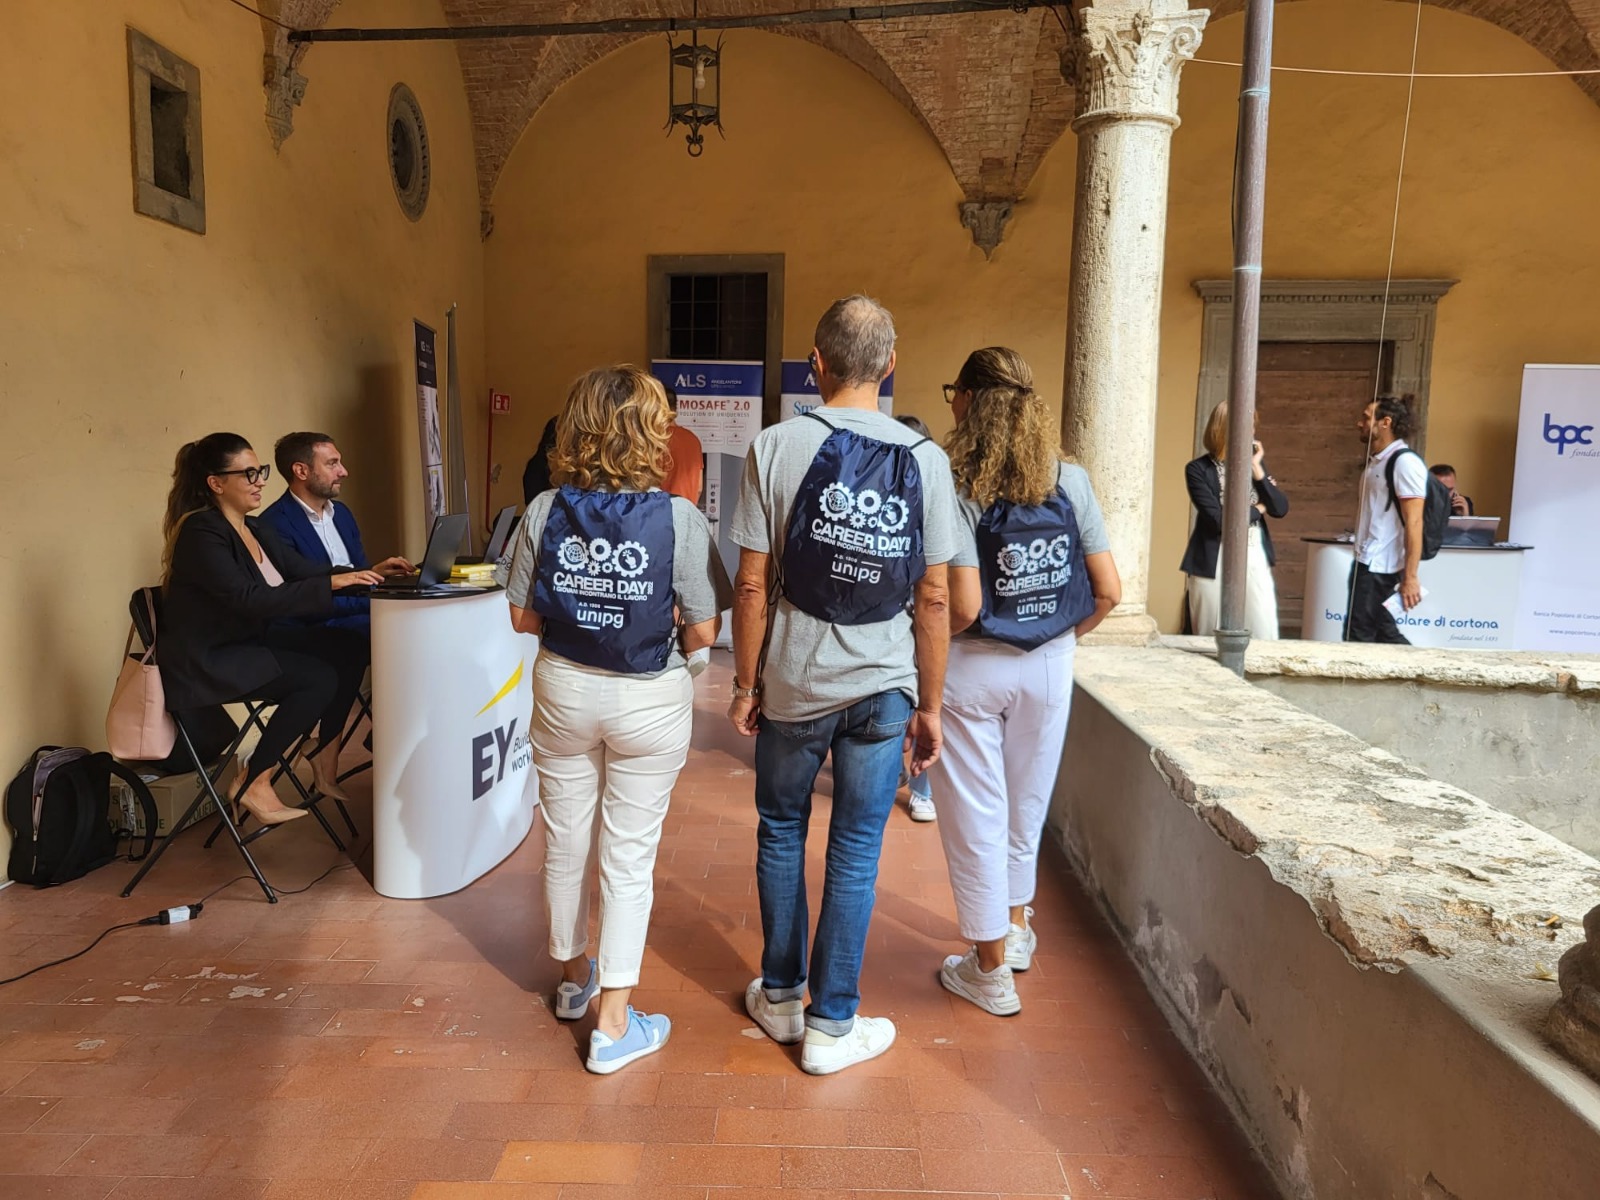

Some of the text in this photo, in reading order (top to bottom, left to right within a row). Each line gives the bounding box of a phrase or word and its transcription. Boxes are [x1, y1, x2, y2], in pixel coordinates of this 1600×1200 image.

[674, 373, 707, 388] ALS
[677, 400, 750, 411] MOSAFE 2.0
[1543, 413, 1594, 455] bpc
[1569, 449, 1600, 459] fondat
[811, 518, 905, 551] CAREER DAY
[813, 534, 835, 545] GIOVANI
[837, 542, 876, 555] INCONTRANO
[831, 561, 881, 584] unipg
[553, 571, 647, 595] CAREER DAY
[995, 573, 1048, 591] CAREER
[580, 590, 616, 599] INCONTRANO
[1017, 601, 1056, 615] unipg
[577, 610, 624, 628] unipg
[1395, 614, 1431, 626] olare
[1434, 615, 1446, 627] di
[1449, 618, 1499, 629] cortona
[472, 717, 518, 802] EY
[511, 748, 533, 773] worki
